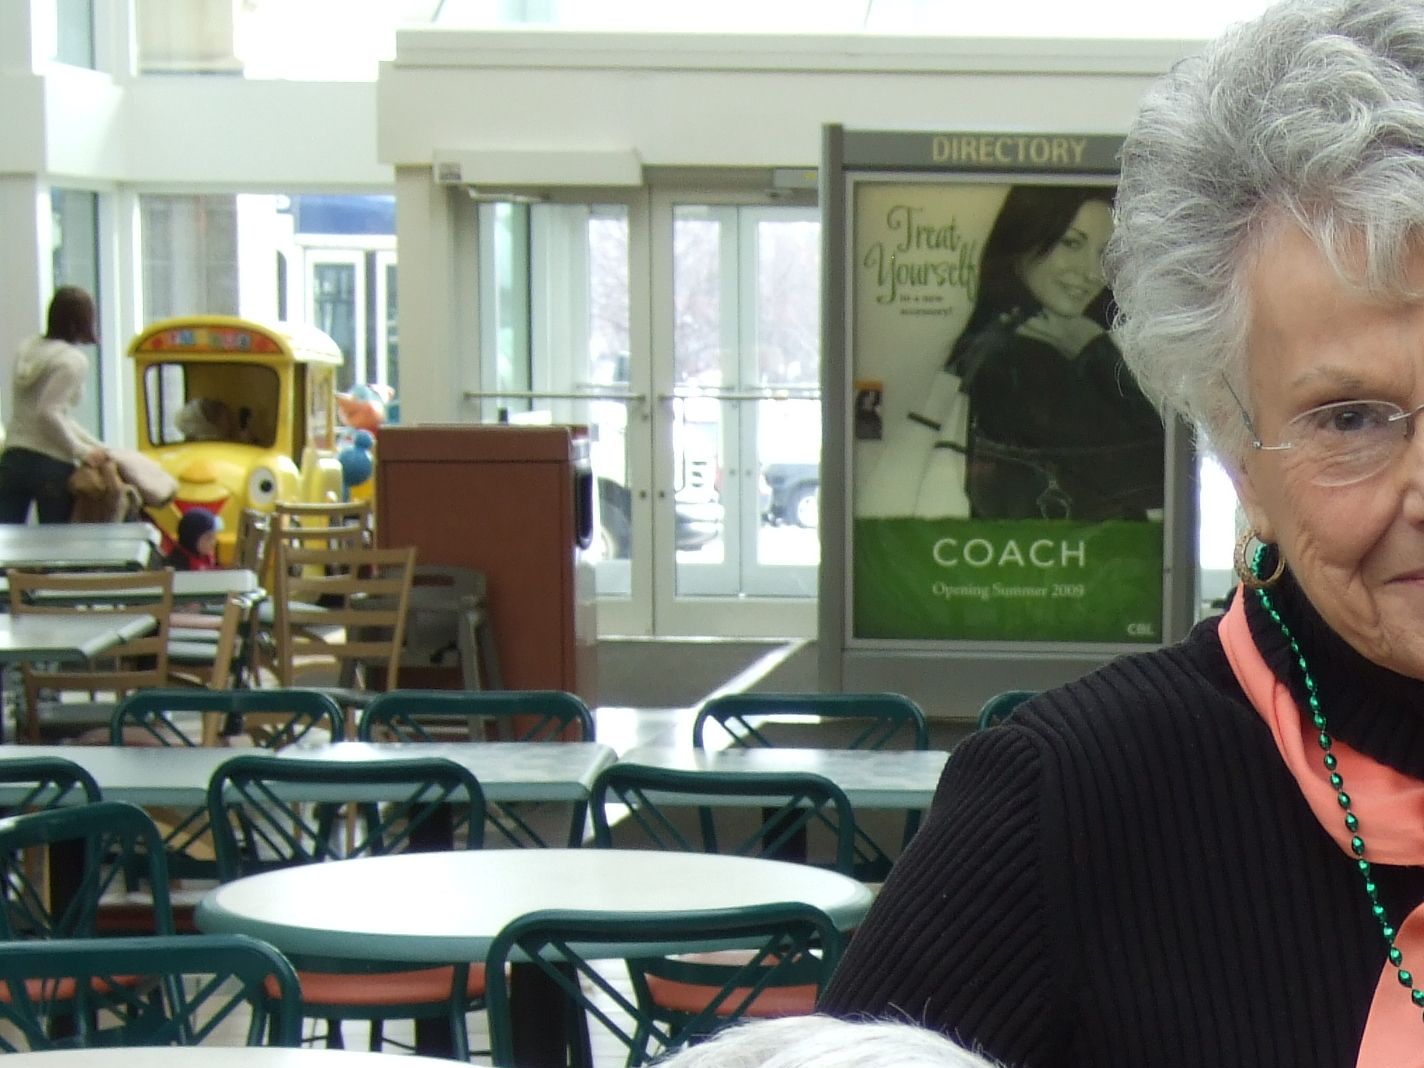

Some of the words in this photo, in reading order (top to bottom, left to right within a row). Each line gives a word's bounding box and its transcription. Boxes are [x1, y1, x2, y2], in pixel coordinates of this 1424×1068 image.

[932, 137, 1087, 163] DIRECTORY
[886, 204, 961, 252] Treat
[863, 241, 979, 303] Yourself
[932, 538, 1087, 569] COACH
[932, 582, 990, 600] Opening
[992, 582, 1048, 598] Summer
